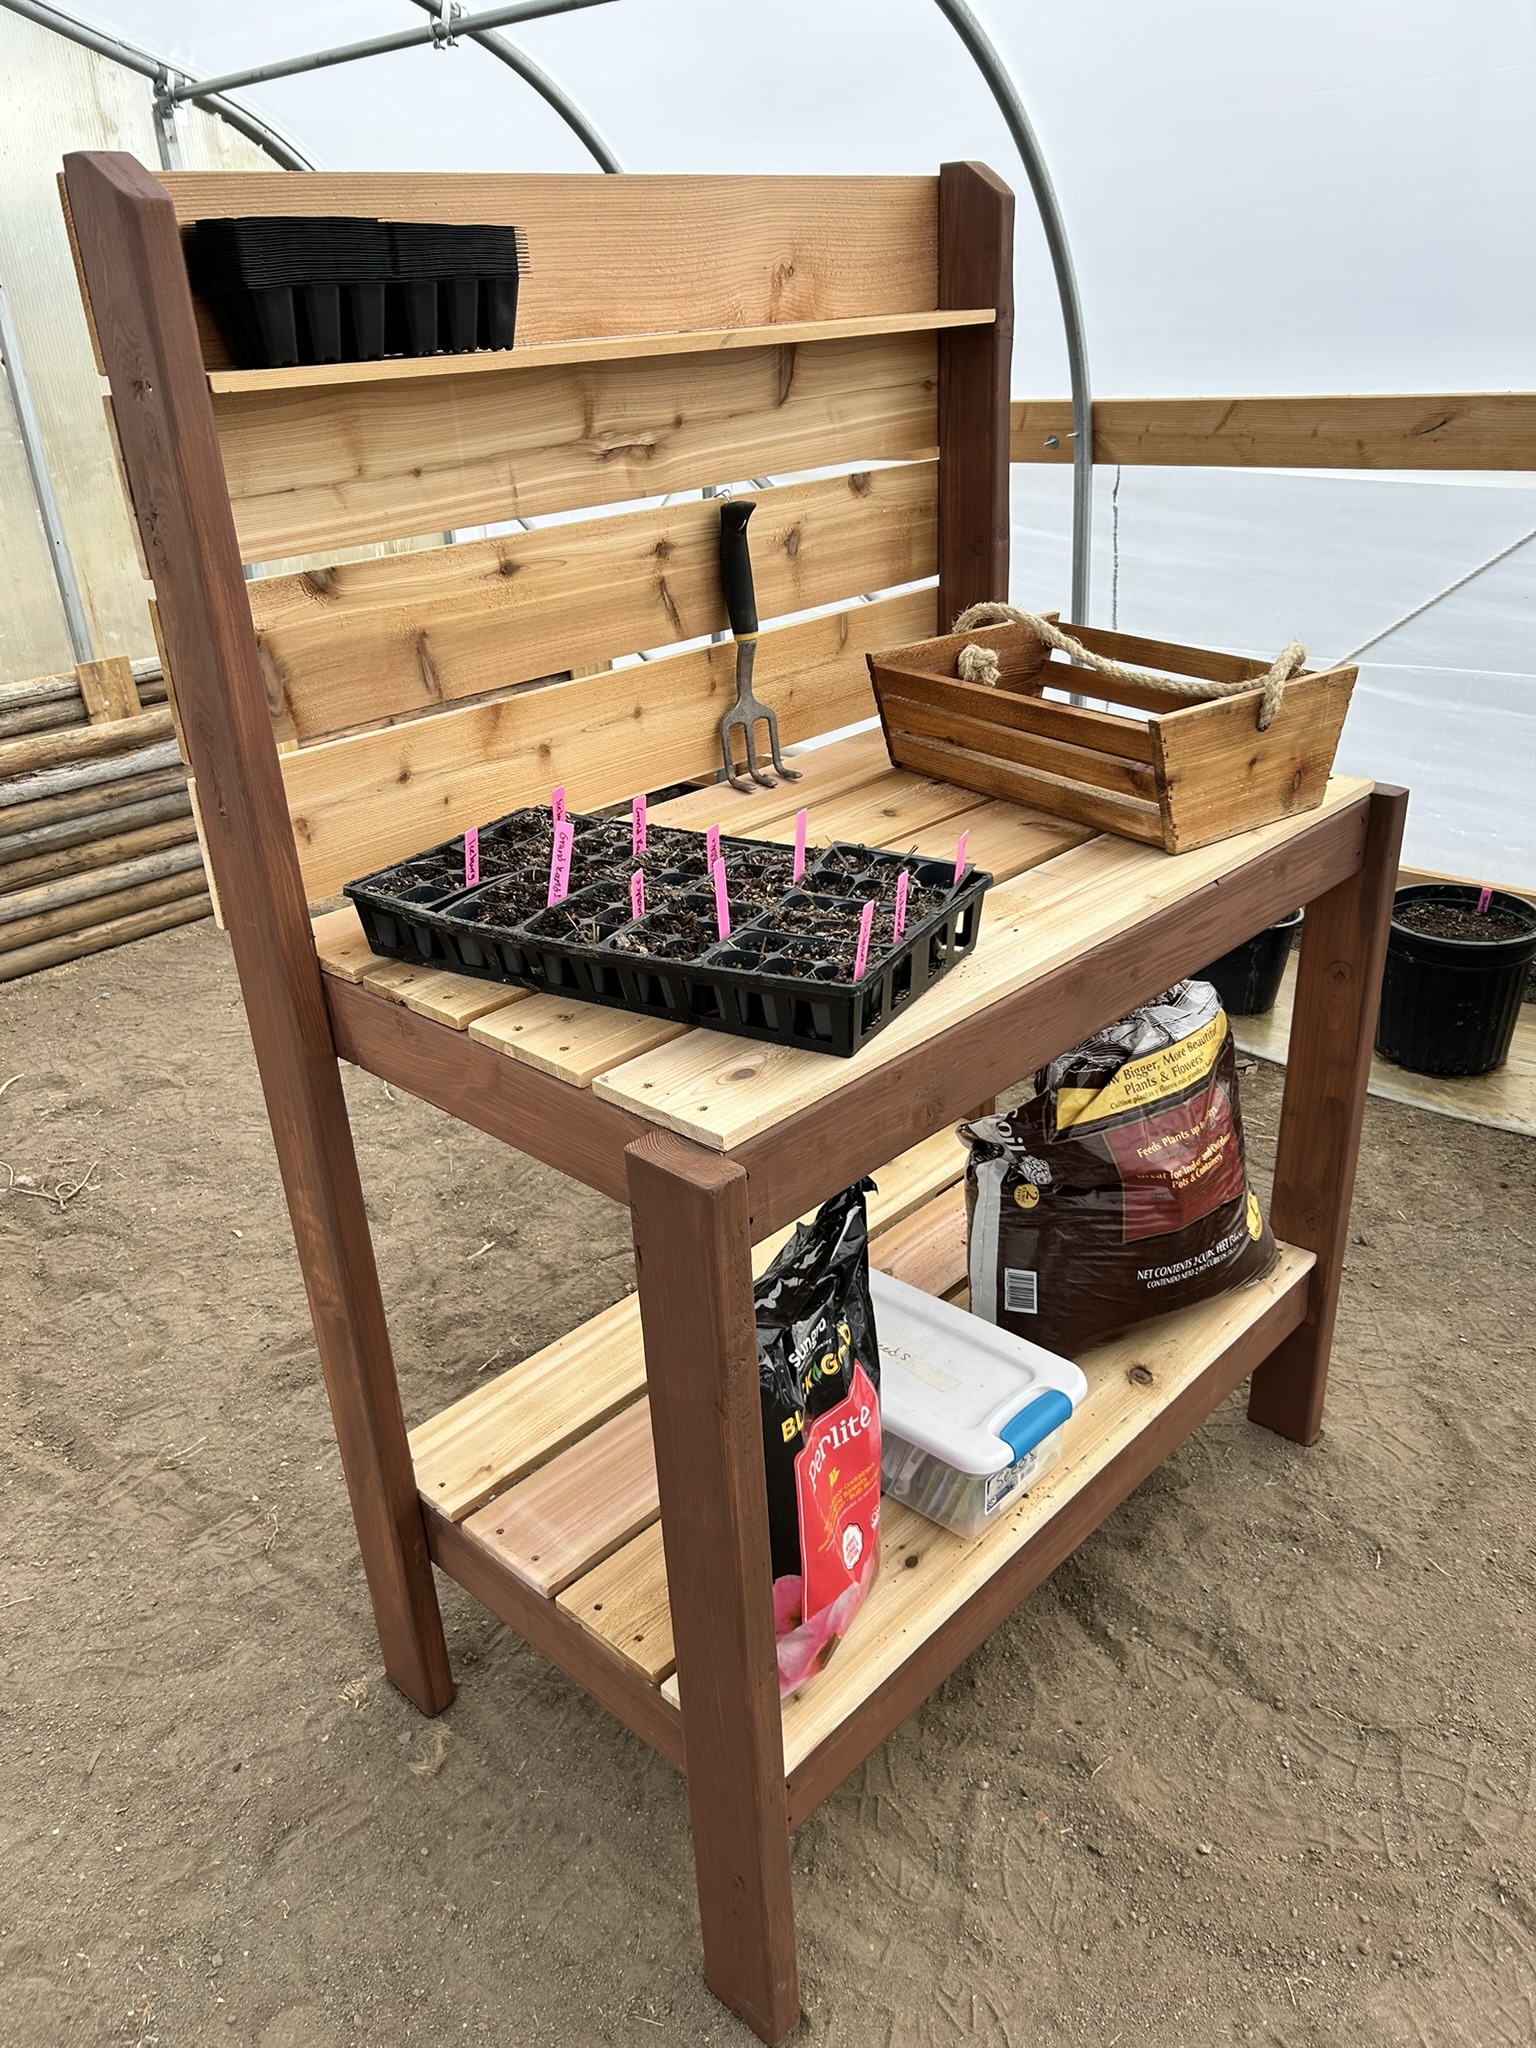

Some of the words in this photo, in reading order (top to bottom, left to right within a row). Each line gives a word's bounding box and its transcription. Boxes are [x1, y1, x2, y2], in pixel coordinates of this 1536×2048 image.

[558, 832, 569, 862] Grand
[1162, 1048, 1186, 1066] More
[1124, 1077, 1157, 1095] Plants
[1160, 1071, 1169, 1082] &
[1137, 1142, 1162, 1158] Feeds
[1161, 1129, 1190, 1147] Plants
[1190, 1125, 1200, 1136] up
[1170, 1170, 1182, 1180] for
[1172, 1178, 1189, 1189] Pots
[1026, 1190, 1039, 1202] 2
[1137, 1268, 1154, 1280] NET
[1154, 1257, 1193, 1278] CONTENTS
[1216, 1237, 1229, 1253] FEET
[809, 1405, 871, 1494] perlite
